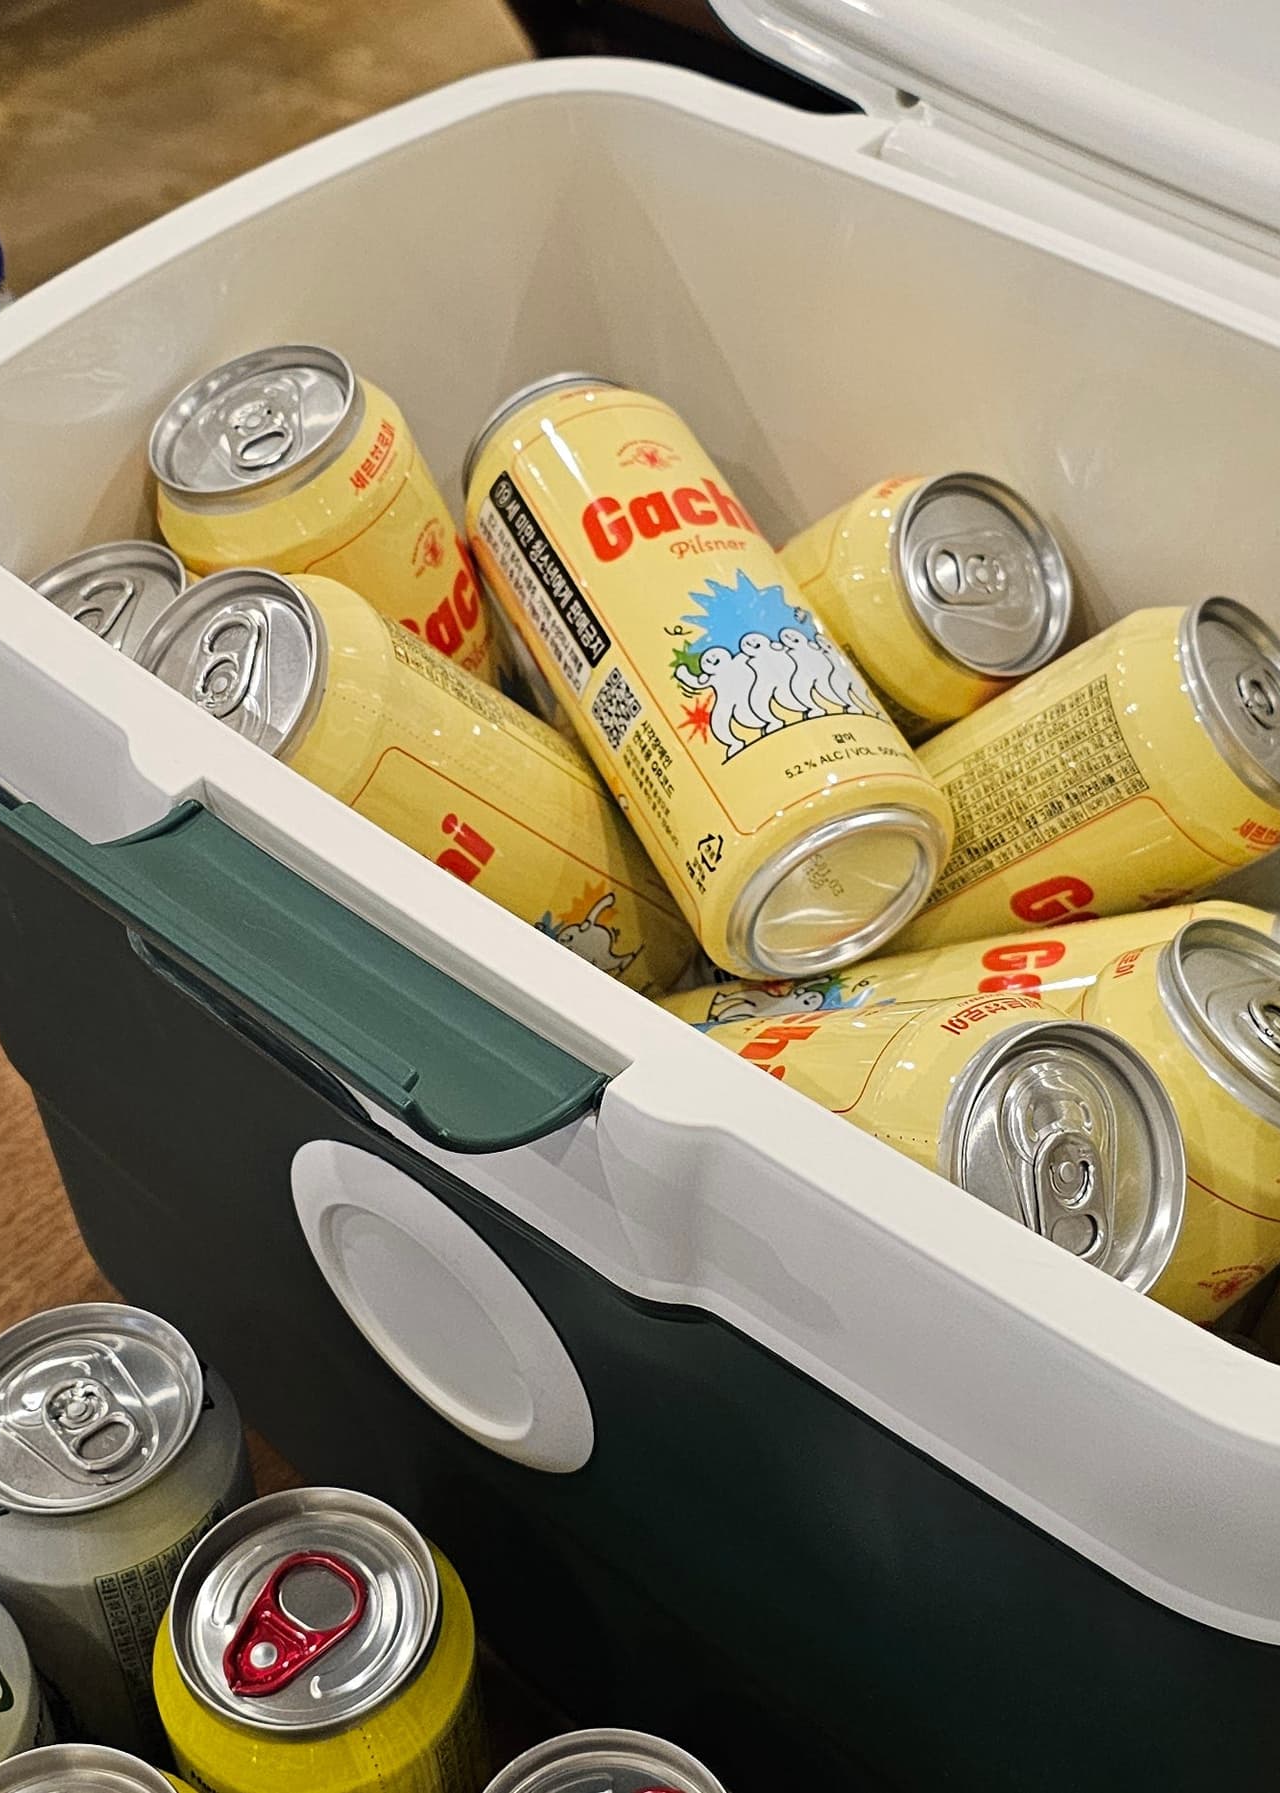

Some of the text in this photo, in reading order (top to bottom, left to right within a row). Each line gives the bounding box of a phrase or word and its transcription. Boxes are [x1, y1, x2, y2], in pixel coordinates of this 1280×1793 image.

[669, 534, 747, 560] Pilsner
[512, 515, 538, 547] 미만
[527, 539, 576, 609] 청소년에게
[564, 600, 606, 662] 판매금지
[784, 764, 804, 779] 5.2
[819, 751, 844, 765] ALC
